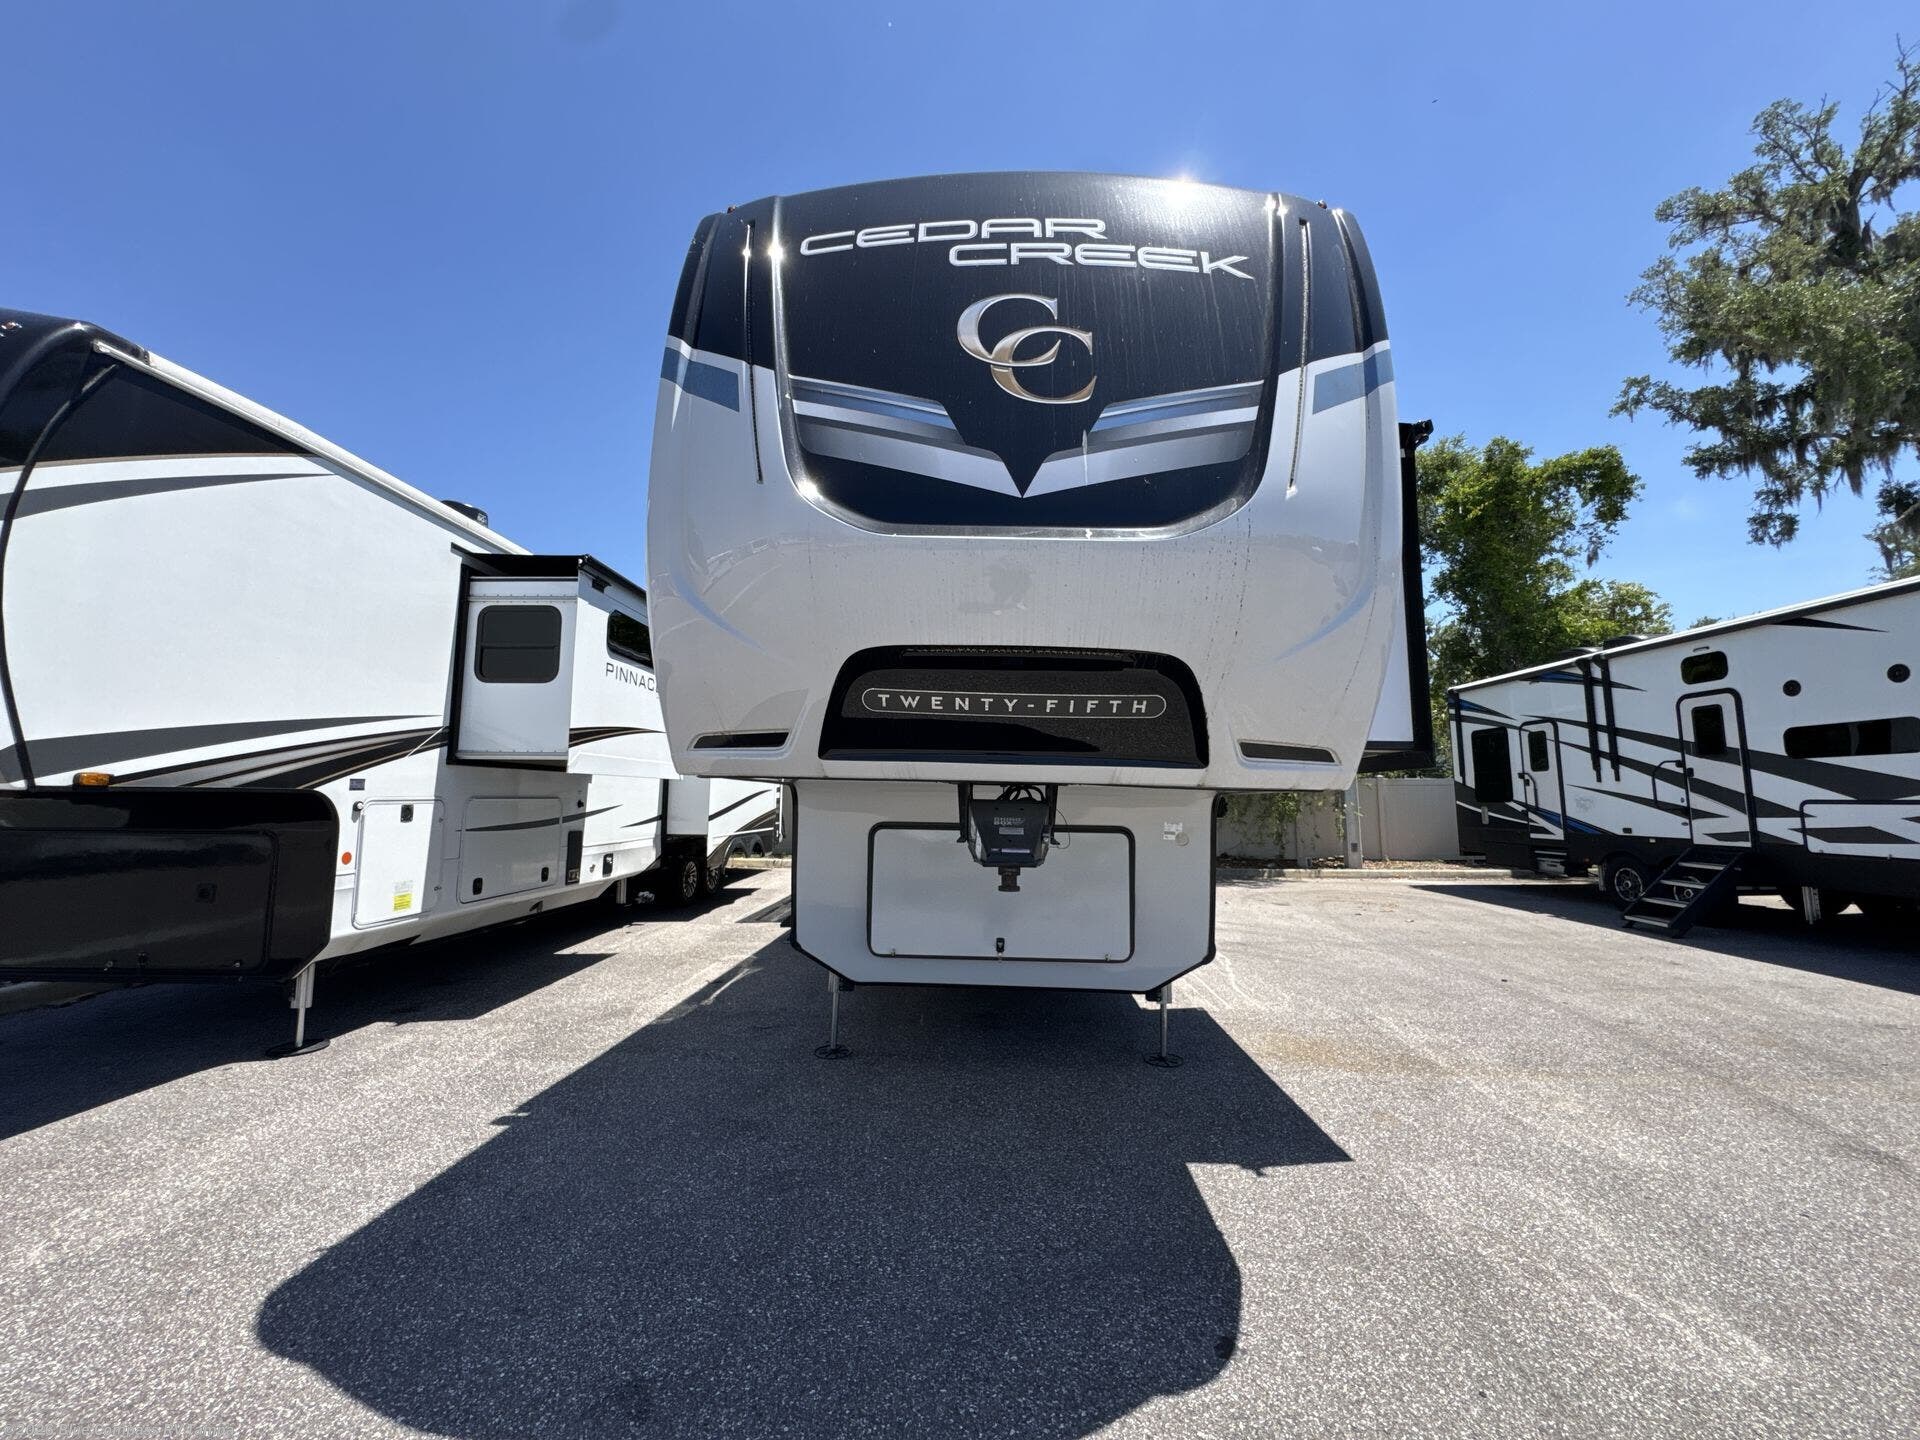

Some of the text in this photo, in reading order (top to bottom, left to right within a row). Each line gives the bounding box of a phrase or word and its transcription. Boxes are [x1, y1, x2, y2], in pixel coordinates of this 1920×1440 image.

[800, 218, 1107, 256] CEDAR
[948, 243, 1254, 280] CREEK
[605, 662, 658, 693] PINNAC
[877, 693, 1148, 714] TWENTY-FIFTH
